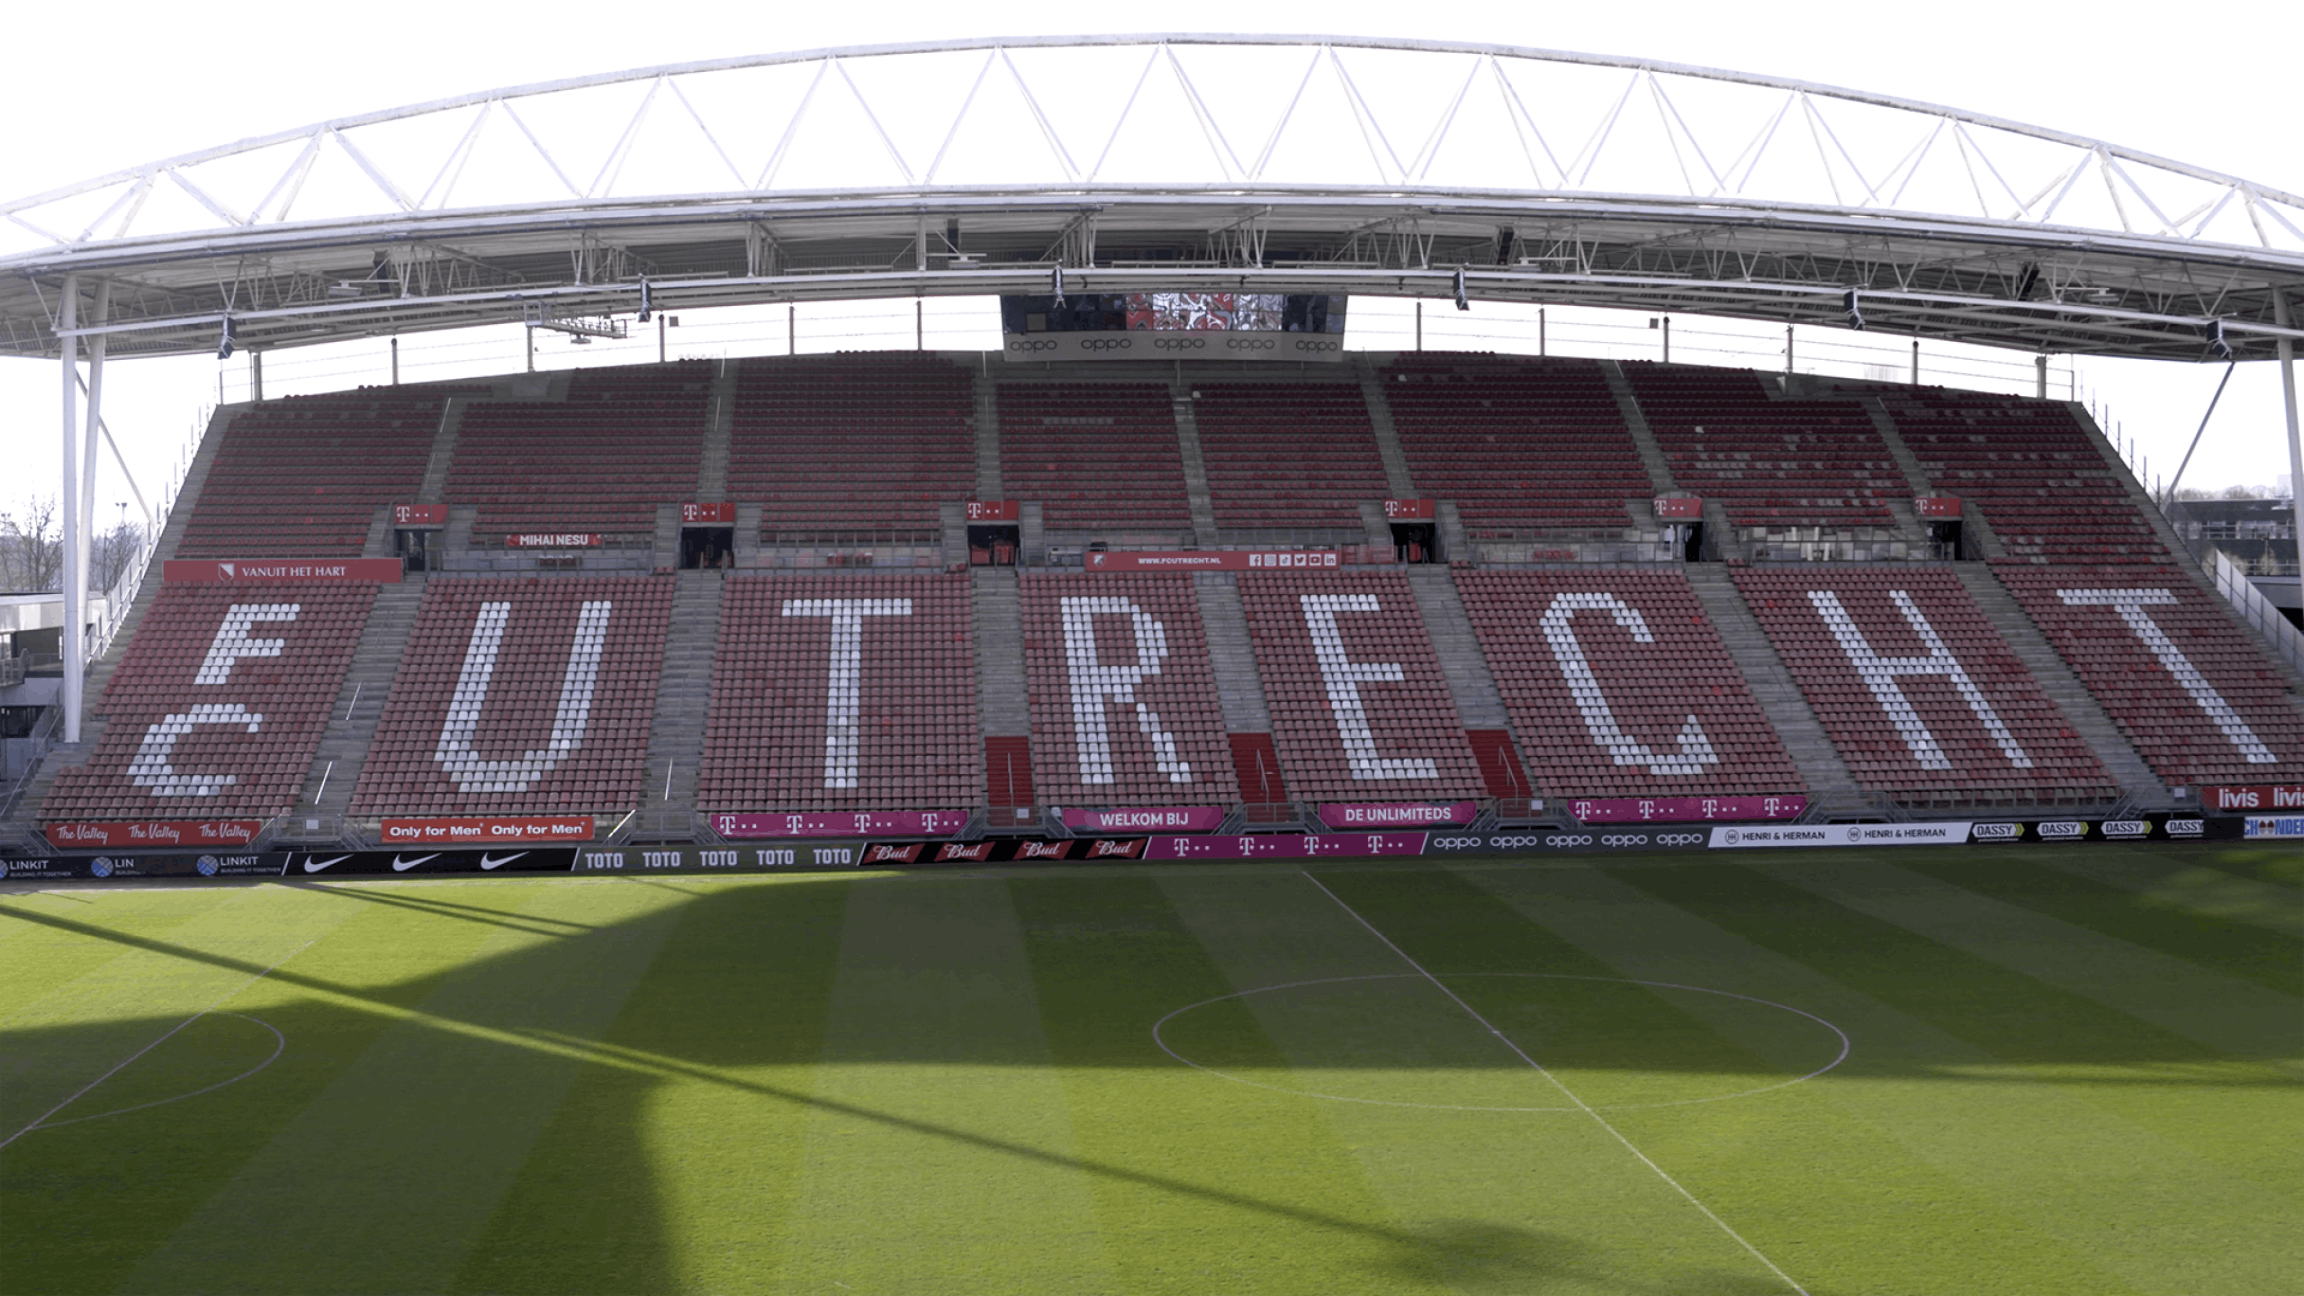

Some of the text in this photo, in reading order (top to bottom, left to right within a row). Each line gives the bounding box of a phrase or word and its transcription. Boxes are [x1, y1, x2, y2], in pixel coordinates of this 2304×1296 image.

[1010, 339, 1058, 354] oppo
[1081, 338, 1132, 352] oppo
[1154, 338, 1205, 352] oppo
[1227, 338, 1275, 352] oppo
[1295, 339, 1338, 353] oppo
[520, 534, 588, 546] MIHAI NESU
[242, 565, 346, 578] VANUIT HET HART
[2219, 788, 2259, 808] livis
[1100, 812, 1189, 827] WELKOM BIJ
[1346, 807, 1452, 822] DE UNLIMITEDS
[57, 825, 109, 844] The Valley
[128, 824, 180, 843] The Valley
[199, 822, 251, 843] The Valley
[390, 826, 421, 838] Only
[425, 825, 447, 836] for
[491, 824, 523, 837] Only
[526, 824, 547, 835] for
[1865, 829, 1893, 838] HENRI
[1904, 829, 1946, 838] HERMAN
[1977, 825, 2013, 836] DASSY
[2042, 823, 2077, 834] DASSY
[2106, 822, 2141, 833] DASSY
[1490, 836, 1537, 849] oppo
[1546, 835, 1592, 848] oppo
[1601, 834, 1648, 847] oppo
[1656, 833, 1703, 846] oppo
[1742, 832, 1772, 841] HENRI
[1783, 831, 1825, 840] HERMAN
[1023, 842, 1060, 857] Bud
[1096, 840, 1132, 855] Bud
[1434, 837, 1481, 850] oppo
[699, 851, 737, 866] TOTO
[756, 850, 794, 865] TOTO
[813, 849, 851, 864] TOTO
[872, 845, 910, 860] Bud
[944, 844, 980, 859] Bud
[10, 860, 49, 870] LINKIT
[220, 856, 259, 866] LINKIT
[585, 853, 623, 868] TOTO
[643, 852, 681, 867] TOTO
